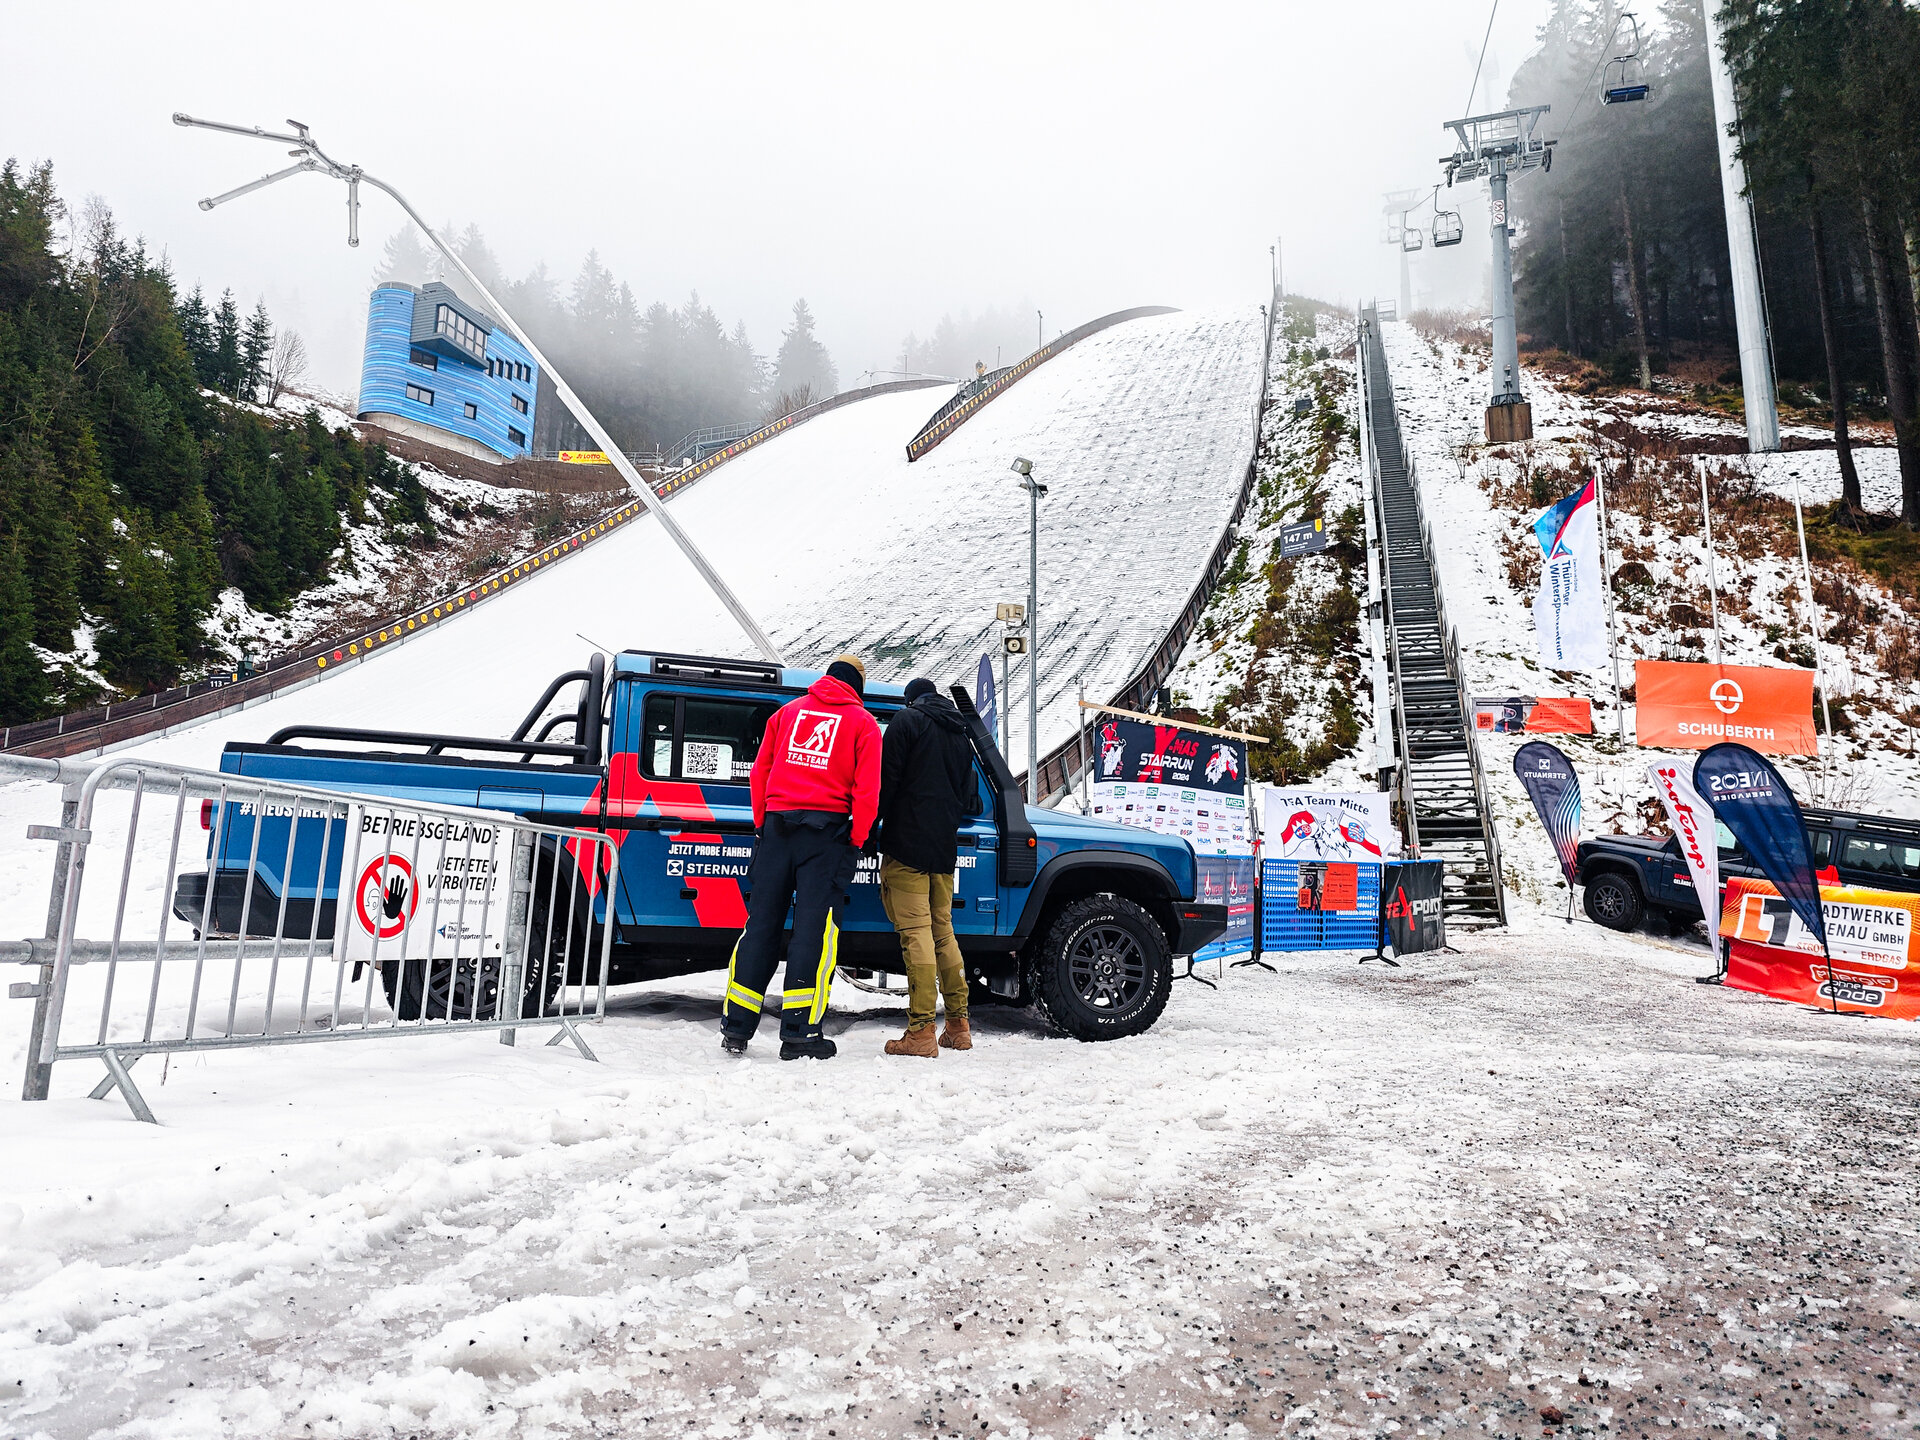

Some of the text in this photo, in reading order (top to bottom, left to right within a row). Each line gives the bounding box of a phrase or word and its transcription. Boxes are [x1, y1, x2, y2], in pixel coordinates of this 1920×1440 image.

[1284, 532, 1313, 544] 147 m
[1561, 559, 1571, 606] Thüringer
[1678, 723, 1775, 741] SCHUBERTH
[787, 752, 829, 766] TFA-TEAM
[1139, 753, 1195, 772] STAIRRUN
[1172, 772, 1190, 782] 2024
[1182, 792, 1196, 801] MSA
[1226, 799, 1245, 807] MSA
[1305, 795, 1336, 806] Team
[1339, 797, 1370, 816] Mitte
[1658, 768, 1706, 869] isotemp
[668, 844, 752, 858] JETZT PROBE FAHREN
[687, 863, 748, 876] STERNAU
[1061, 914, 1115, 960] BFGoodrich
[1872, 932, 1904, 945] GMBH
[1861, 951, 1902, 965] ERDGAS
[1098, 969, 1159, 1025] All-Terrain T/A
[1823, 985, 1879, 1002] ende
